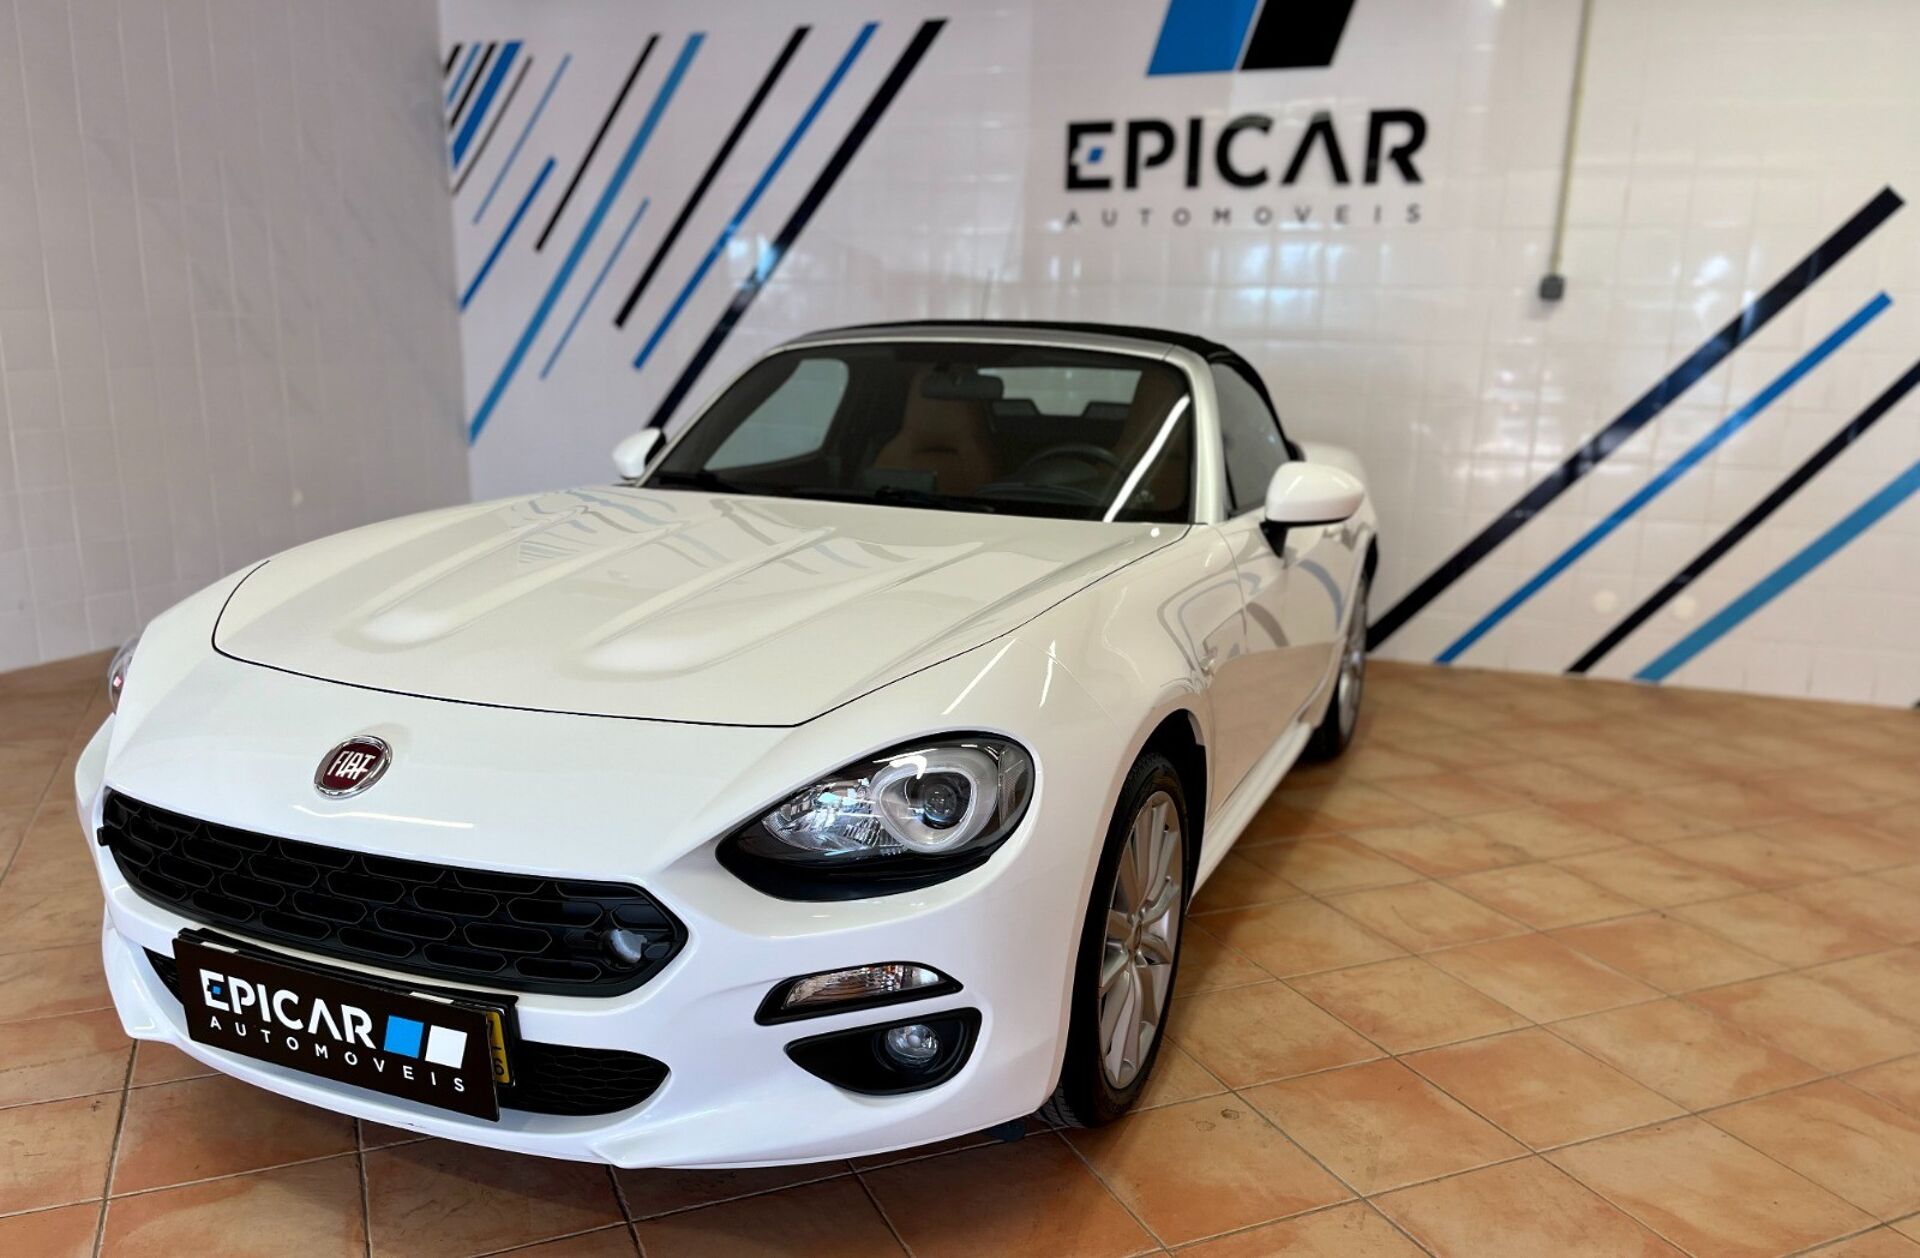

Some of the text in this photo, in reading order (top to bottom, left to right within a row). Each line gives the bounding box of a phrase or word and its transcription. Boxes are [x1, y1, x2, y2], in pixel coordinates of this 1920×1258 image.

[1065, 109, 1428, 191] EPICAR
[1066, 204, 1422, 227] AUTOMOVEIS
[326, 750, 376, 780] FIAT
[200, 968, 377, 1049] EPICAR
[210, 1016, 465, 1092] AUTOMOVEIS
